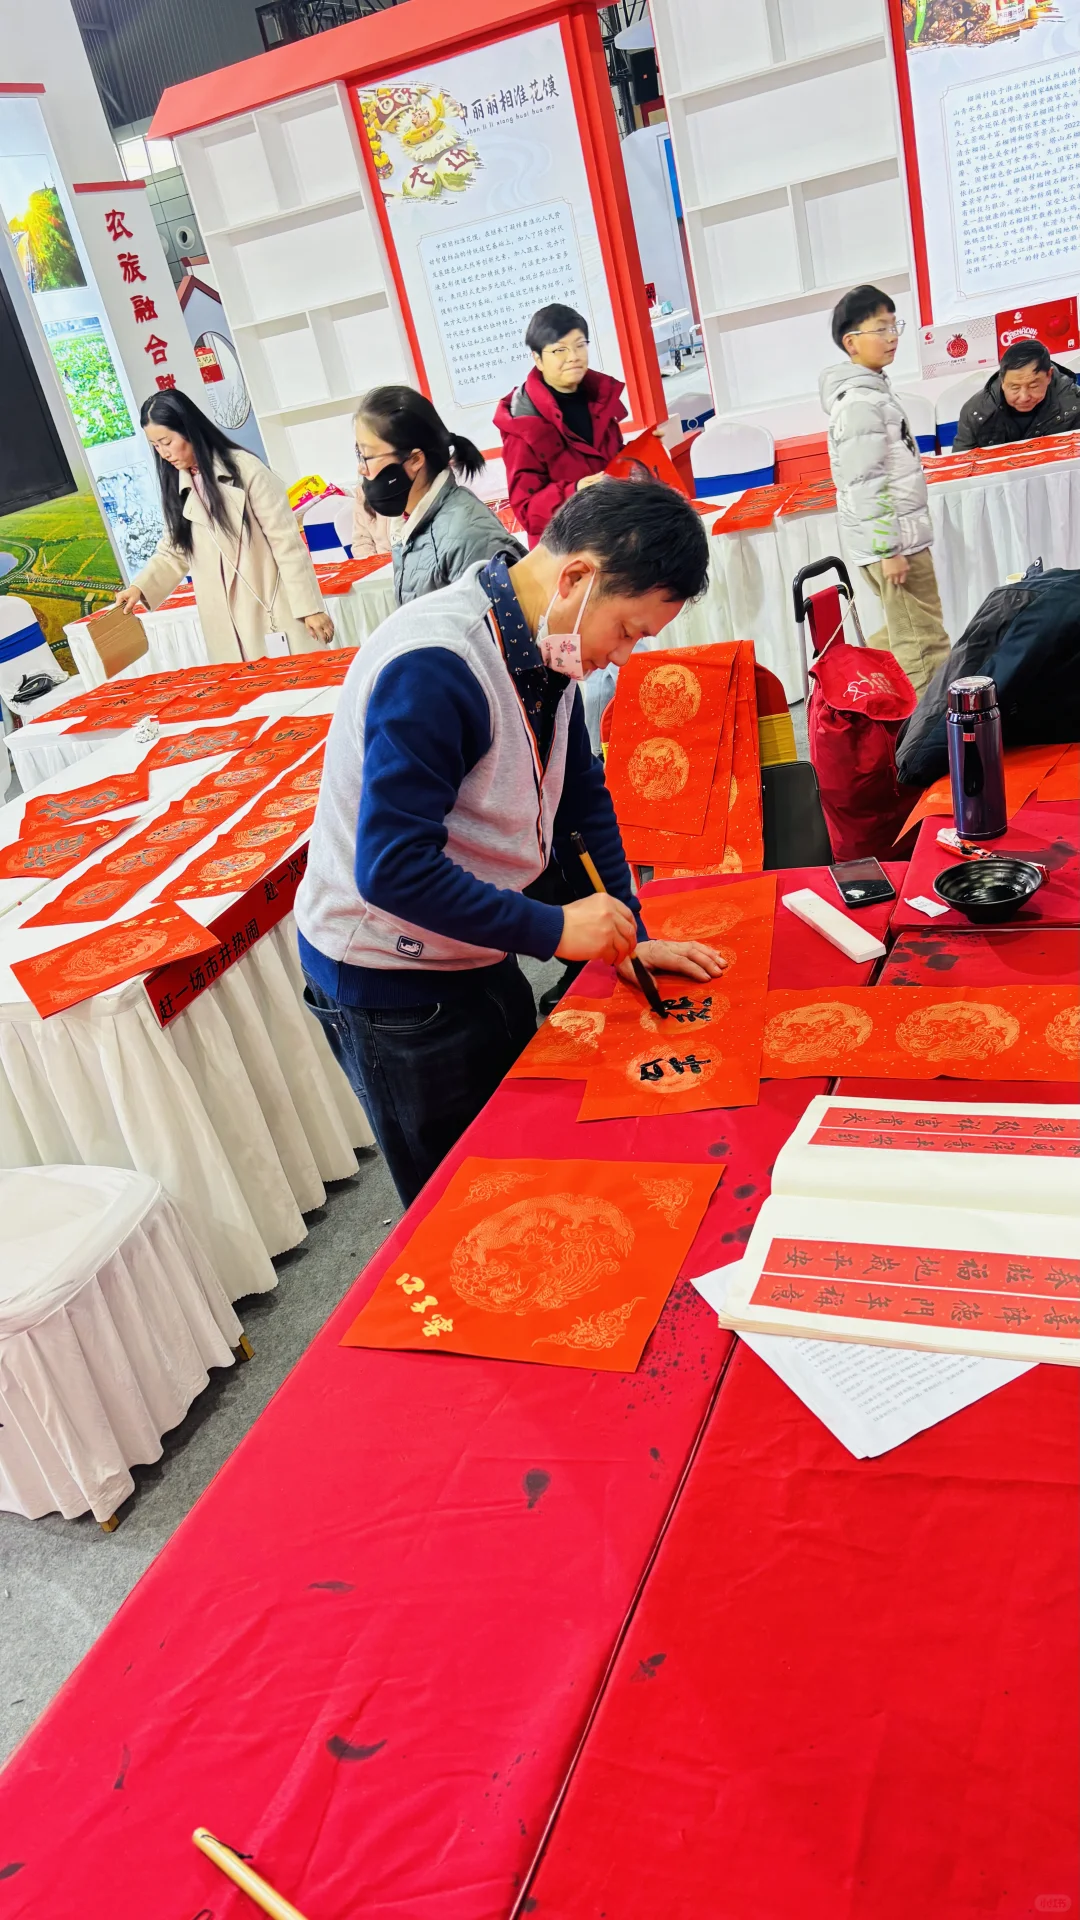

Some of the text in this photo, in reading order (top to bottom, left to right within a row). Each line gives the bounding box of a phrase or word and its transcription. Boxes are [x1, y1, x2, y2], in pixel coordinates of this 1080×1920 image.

[158, 918, 261, 1024] 赶一场市井热闹
